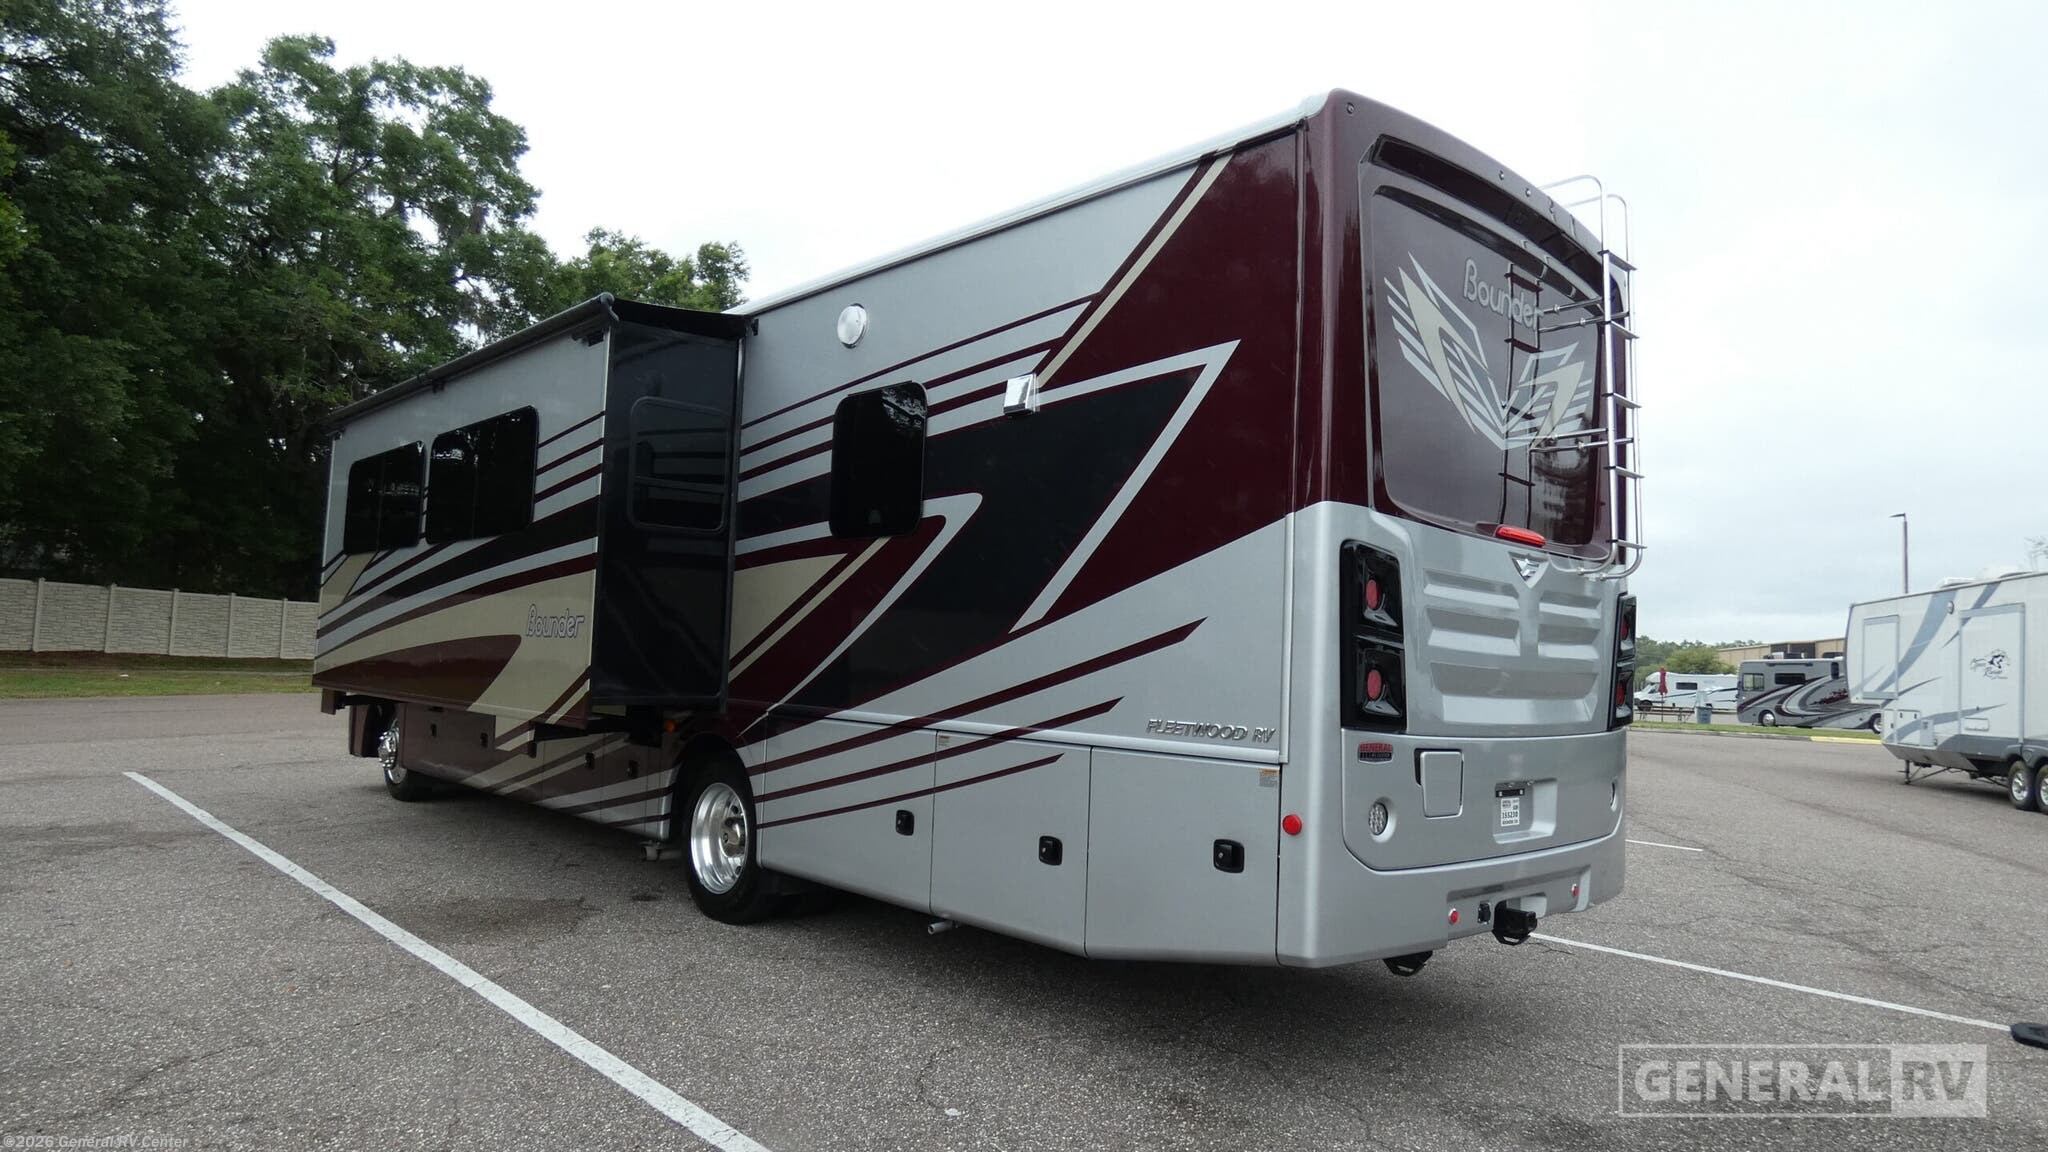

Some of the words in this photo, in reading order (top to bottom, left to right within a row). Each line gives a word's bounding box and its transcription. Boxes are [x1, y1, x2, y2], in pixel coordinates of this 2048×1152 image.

[1463, 257, 1545, 331] Bounder
[526, 603, 585, 638] Bounder
[1146, 719, 1248, 740] FLEETWOOD
[1252, 727, 1276, 743] RV
